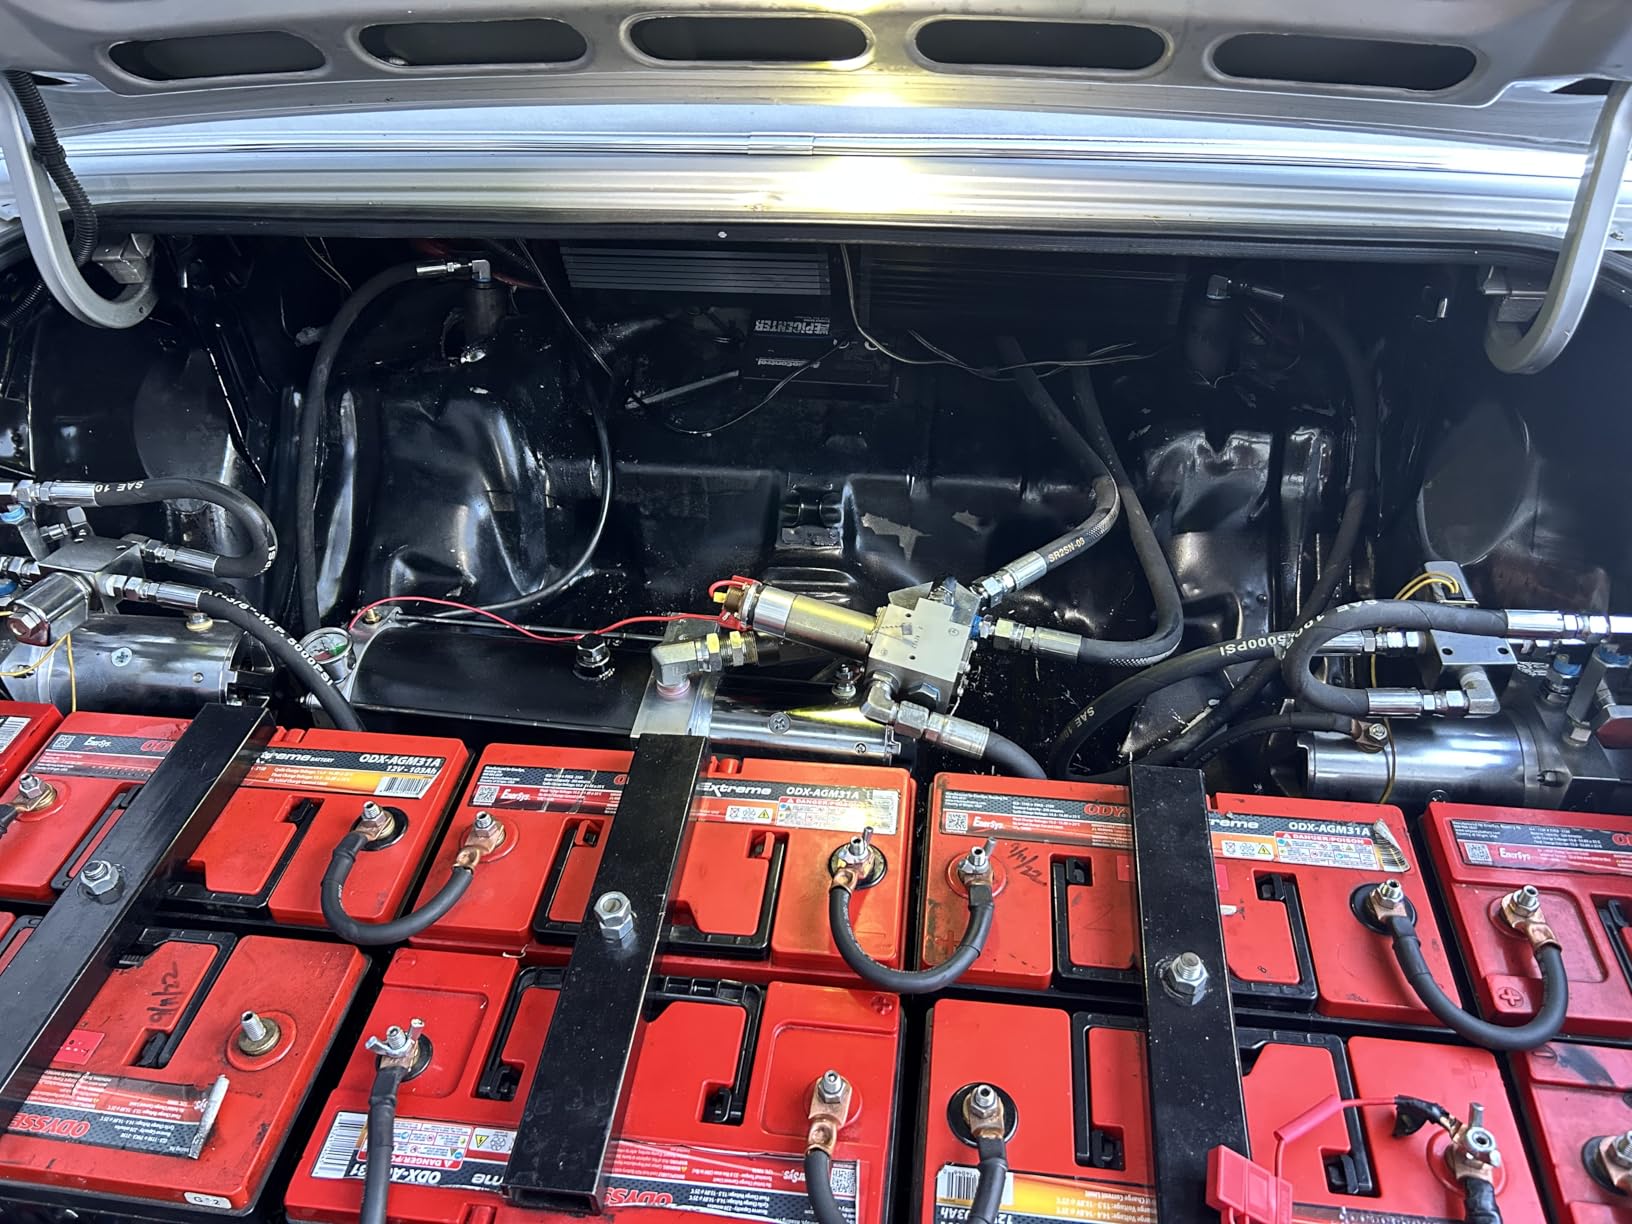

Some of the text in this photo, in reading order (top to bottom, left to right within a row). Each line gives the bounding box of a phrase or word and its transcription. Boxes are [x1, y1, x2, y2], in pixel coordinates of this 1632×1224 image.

[116, 481, 144, 492] SAE
[1219, 636, 1287, 657] 5000PSI
[287, 638, 334, 687] 5000PSI
[1074, 706, 1096, 729] SAE
[359, 753, 442, 768] ODX-AGM31A
[386, 765, 405, 773] 12V
[409, 766, 438, 775] 103Ah
[500, 788, 531, 802] EnerSys
[697, 782, 772, 798] Extreme
[786, 786, 859, 800] ODX-AGM31A
[972, 815, 1004, 831] EnerSys
[1288, 822, 1371, 837] ODX-AGM31A
[8, 1113, 91, 1139] ODYSSE
